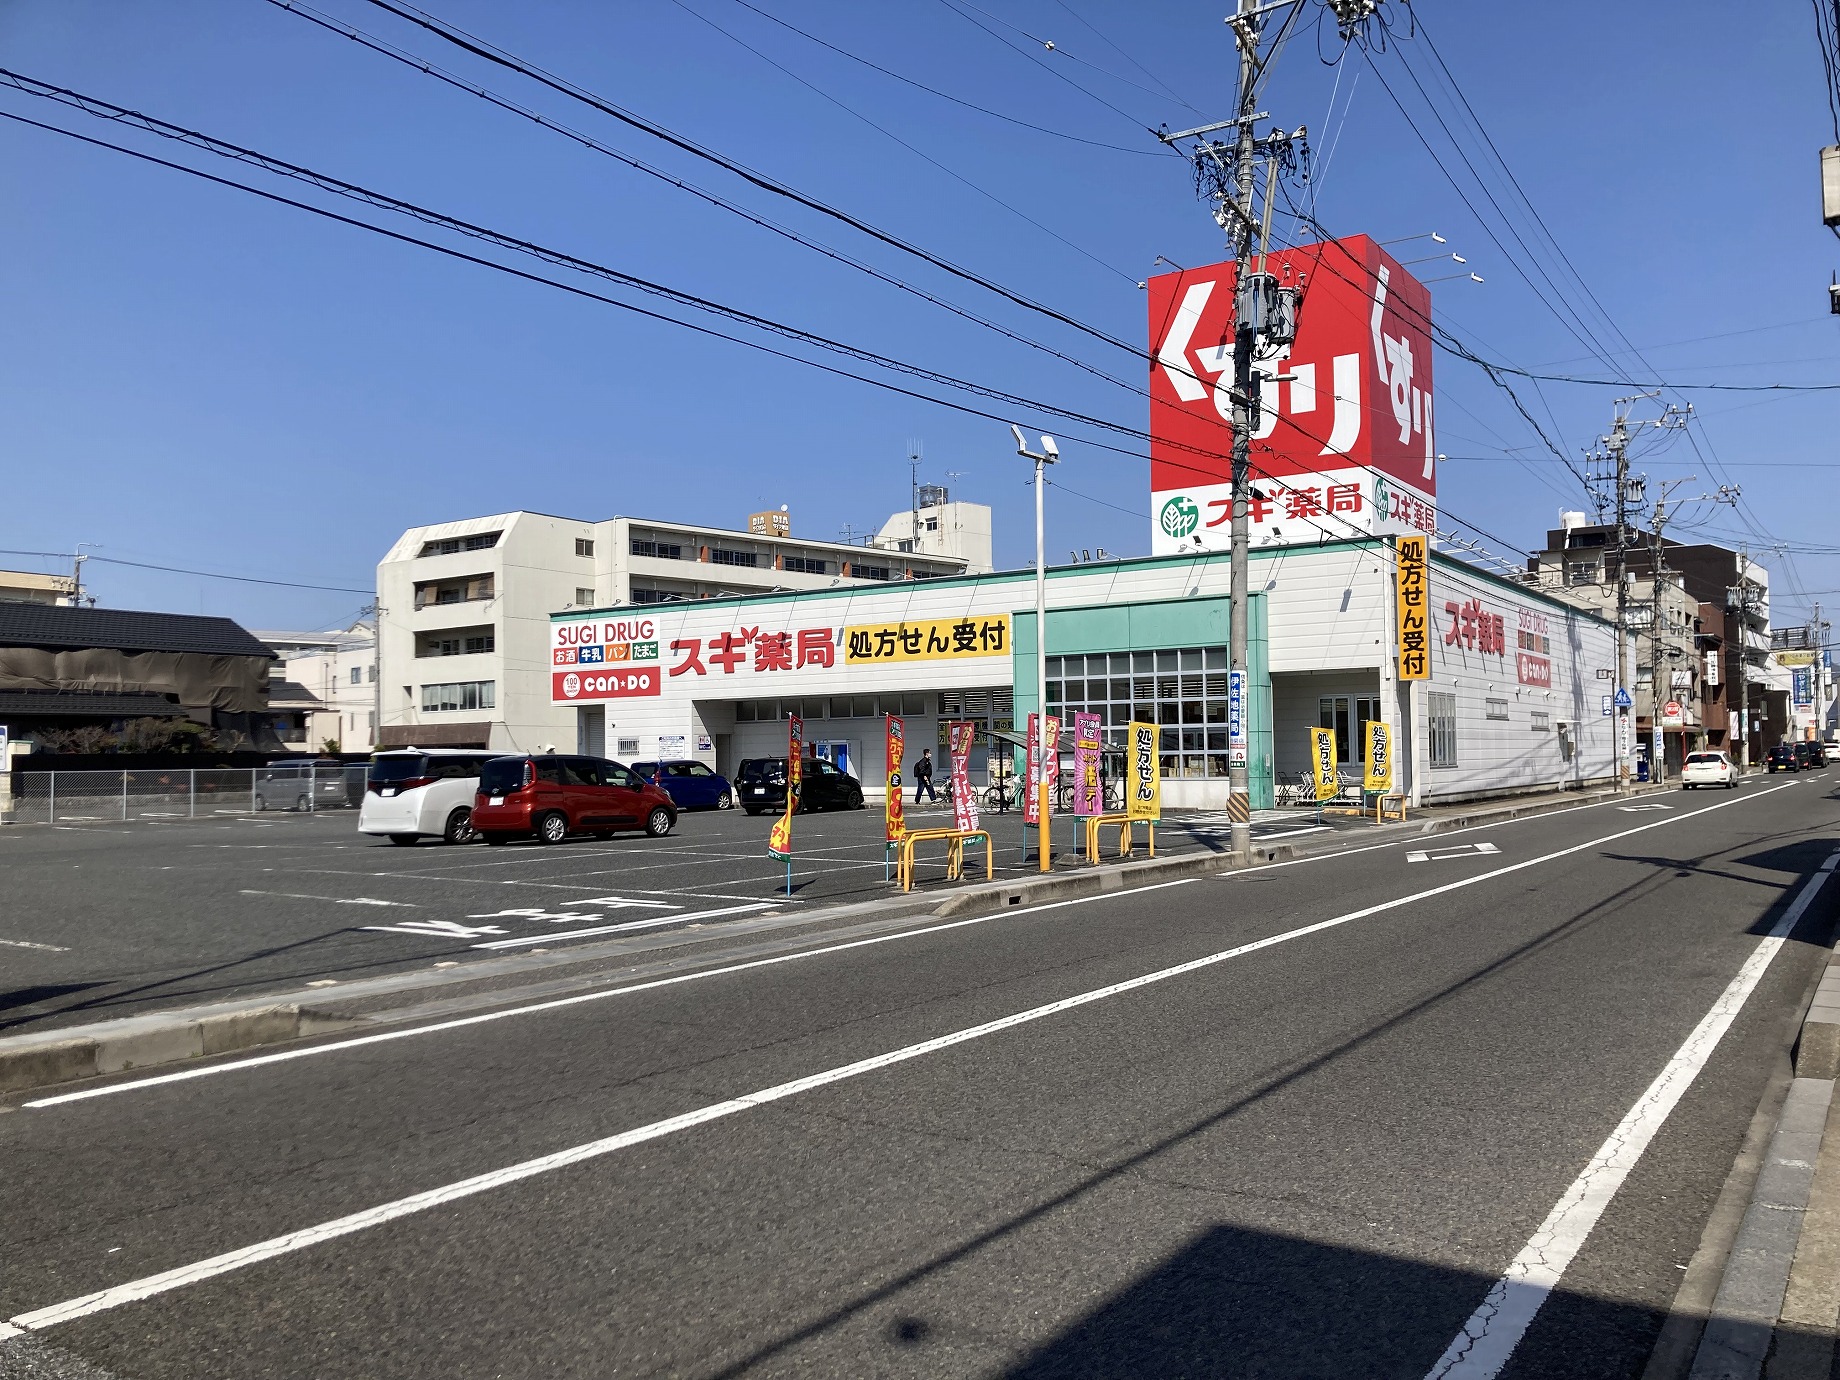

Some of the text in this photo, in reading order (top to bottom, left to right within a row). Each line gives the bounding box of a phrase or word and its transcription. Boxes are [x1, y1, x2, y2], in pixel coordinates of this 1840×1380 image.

[1158, 280, 1362, 457] くすり
[1371, 263, 1433, 481] くすり
[1206, 482, 1362, 527] スギ薬局
[1400, 541, 1426, 676] 処方せん受付
[1445, 597, 1506, 658] スギ薬局
[555, 649, 576, 663] お酒
[558, 620, 655, 646] SUGI DRUG
[581, 647, 602, 662] 牛乳
[608, 646, 629, 660] パン
[633, 643, 657, 658] たまご
[669, 627, 835, 677] スギ薬局
[849, 620, 1006, 660] 処方せん受付
[566, 677, 578, 686] 100
[1136, 726, 1154, 801] 処方せん
[1318, 730, 1334, 785] 処方せん
[1371, 725, 1387, 777] 処方せん
